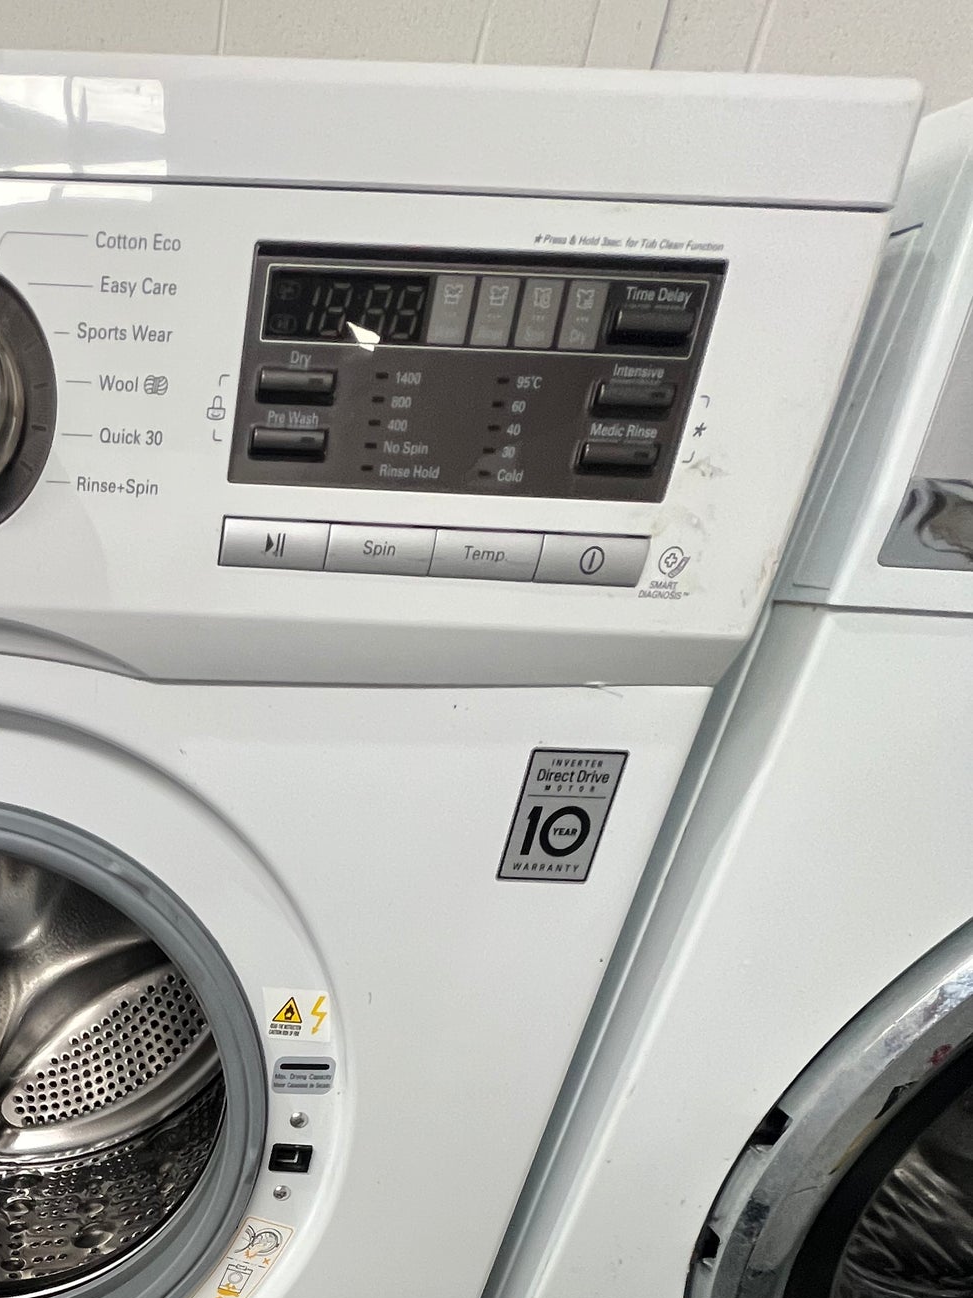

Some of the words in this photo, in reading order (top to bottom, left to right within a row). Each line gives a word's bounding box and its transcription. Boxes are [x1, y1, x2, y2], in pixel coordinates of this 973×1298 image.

[96, 231, 147, 250] Cotton
[153, 233, 181, 251] Eco
[569, 235, 576, 245] &
[578, 235, 600, 246] Hold
[625, 236, 639, 248] for
[640, 238, 656, 250] Tub
[659, 239, 684, 250] Clean
[685, 240, 724, 251] Function
[100, 275, 137, 297] Easy
[142, 277, 177, 296] Care
[627, 286, 656, 302] Time
[658, 287, 693, 308] Delay
[77, 322, 127, 343] Sports
[132, 325, 173, 342] Wear
[291, 350, 312, 368] Dry
[395, 372, 422, 385] 1400
[613, 363, 665, 379] Intensive
[99, 374, 139, 392] Wool
[391, 396, 412, 409] 800
[511, 400, 526, 413] 60
[268, 410, 286, 424] Pre
[289, 411, 319, 425] Wash
[387, 419, 408, 432] 400
[507, 423, 521, 436] 40
[590, 422, 625, 437] Medic
[626, 424, 658, 439] Rinse
[99, 427, 141, 446] Quick
[145, 430, 163, 446] 30
[383, 441, 400, 454] No
[402, 442, 429, 456] Spin
[501, 446, 516, 459] 30
[379, 464, 410, 478] Rinse
[413, 465, 440, 479] Hold
[497, 469, 524, 483] Cold
[76, 475, 159, 498] Rinse+Spin
[363, 539, 396, 558] Spin
[464, 545, 508, 562] Temp.
[649, 580, 678, 590] SMART
[551, 759, 603, 768] INVERTER
[537, 768, 574, 783] Direct
[576, 770, 610, 784] Drive
[544, 784, 596, 793] MOTOR
[520, 805, 591, 857] 10
[553, 827, 578, 836] YEAR
[512, 862, 580, 873] WARRANTY
